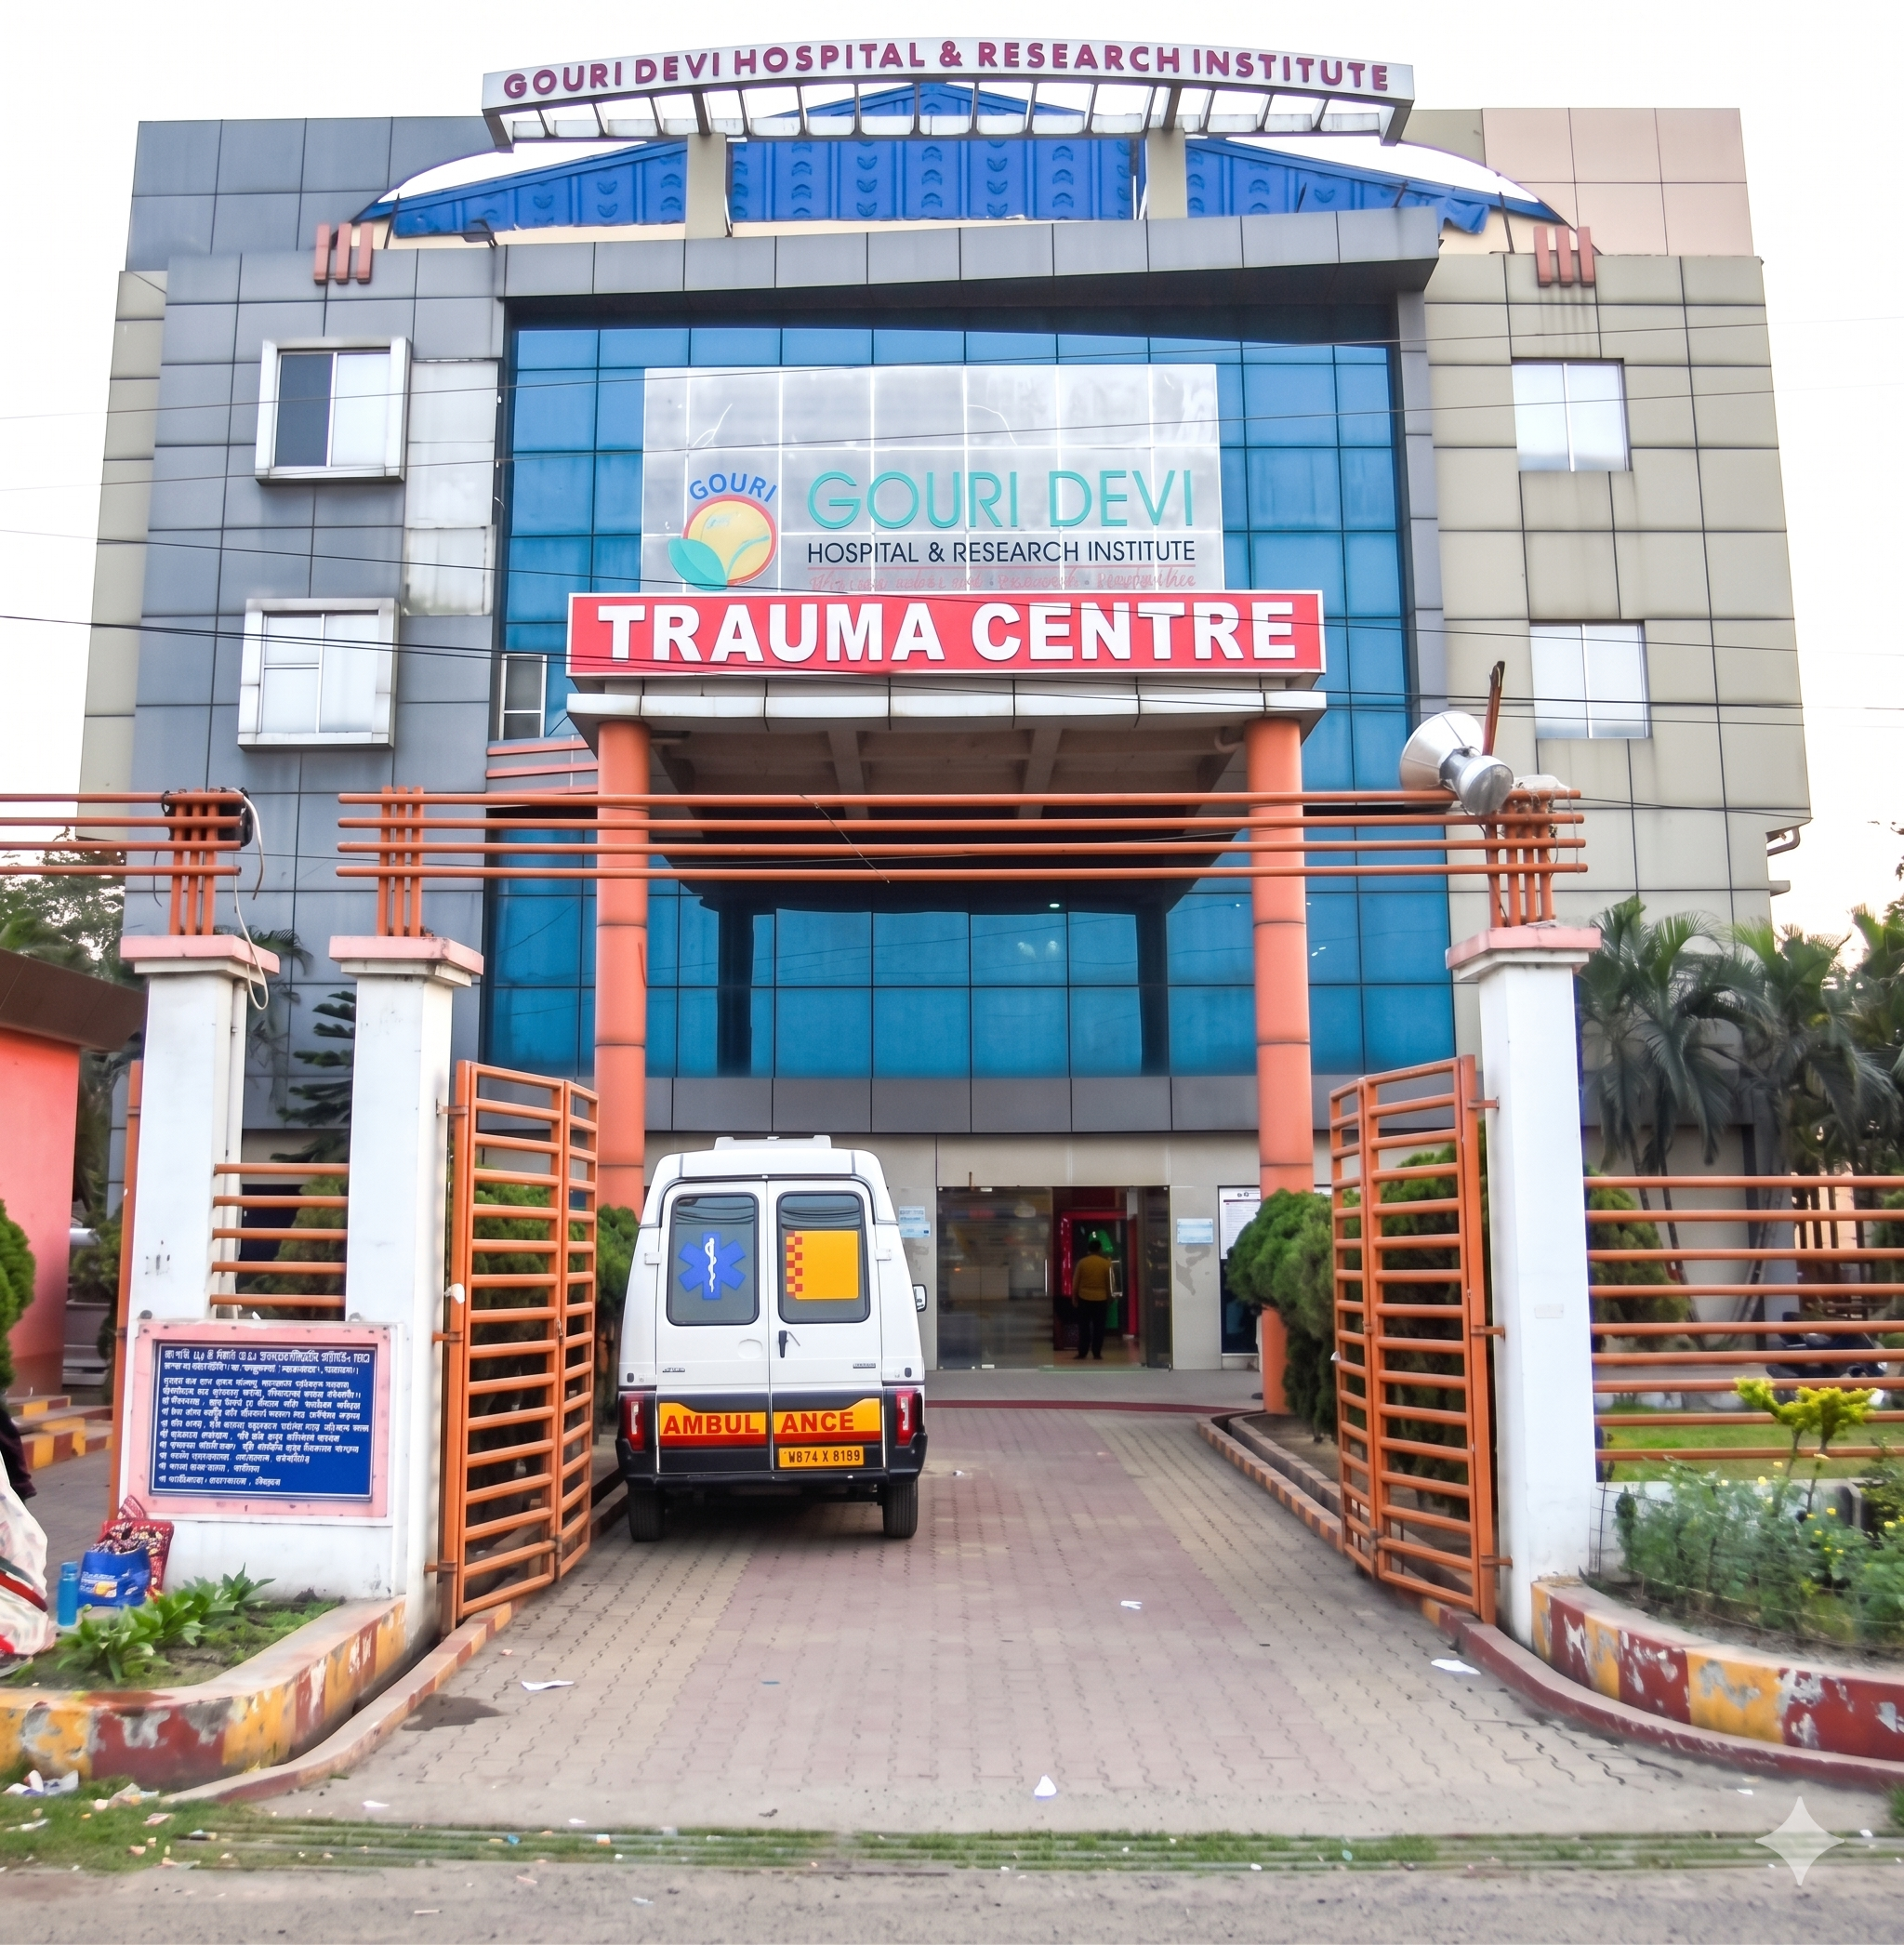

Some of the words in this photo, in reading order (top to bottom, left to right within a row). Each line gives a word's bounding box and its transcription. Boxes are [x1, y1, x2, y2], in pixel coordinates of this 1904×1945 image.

[504, 64, 621, 98] GOURI
[635, 52, 719, 83] DEVI
[734, 43, 924, 73] HOSPITAL
[939, 41, 962, 66] &
[979, 42, 1180, 72] RESEARCH
[1194, 49, 1388, 91] INSTITUTE
[689, 472, 777, 502] GOURI
[807, 470, 1019, 530] GOURI
[1049, 470, 1194, 528] DEVI
[807, 542, 919, 563] HOSPITAL
[928, 541, 945, 563] &
[953, 542, 1078, 563] RESEARCH
[1088, 540, 1196, 562] INSTITUTE
[597, 602, 945, 663] TRAUMA
[971, 601, 1296, 661] CENTRE
[663, 1414, 760, 1435] AMBUL
[780, 1411, 854, 1434] ANCE
[822, 1449, 829, 1462] X
